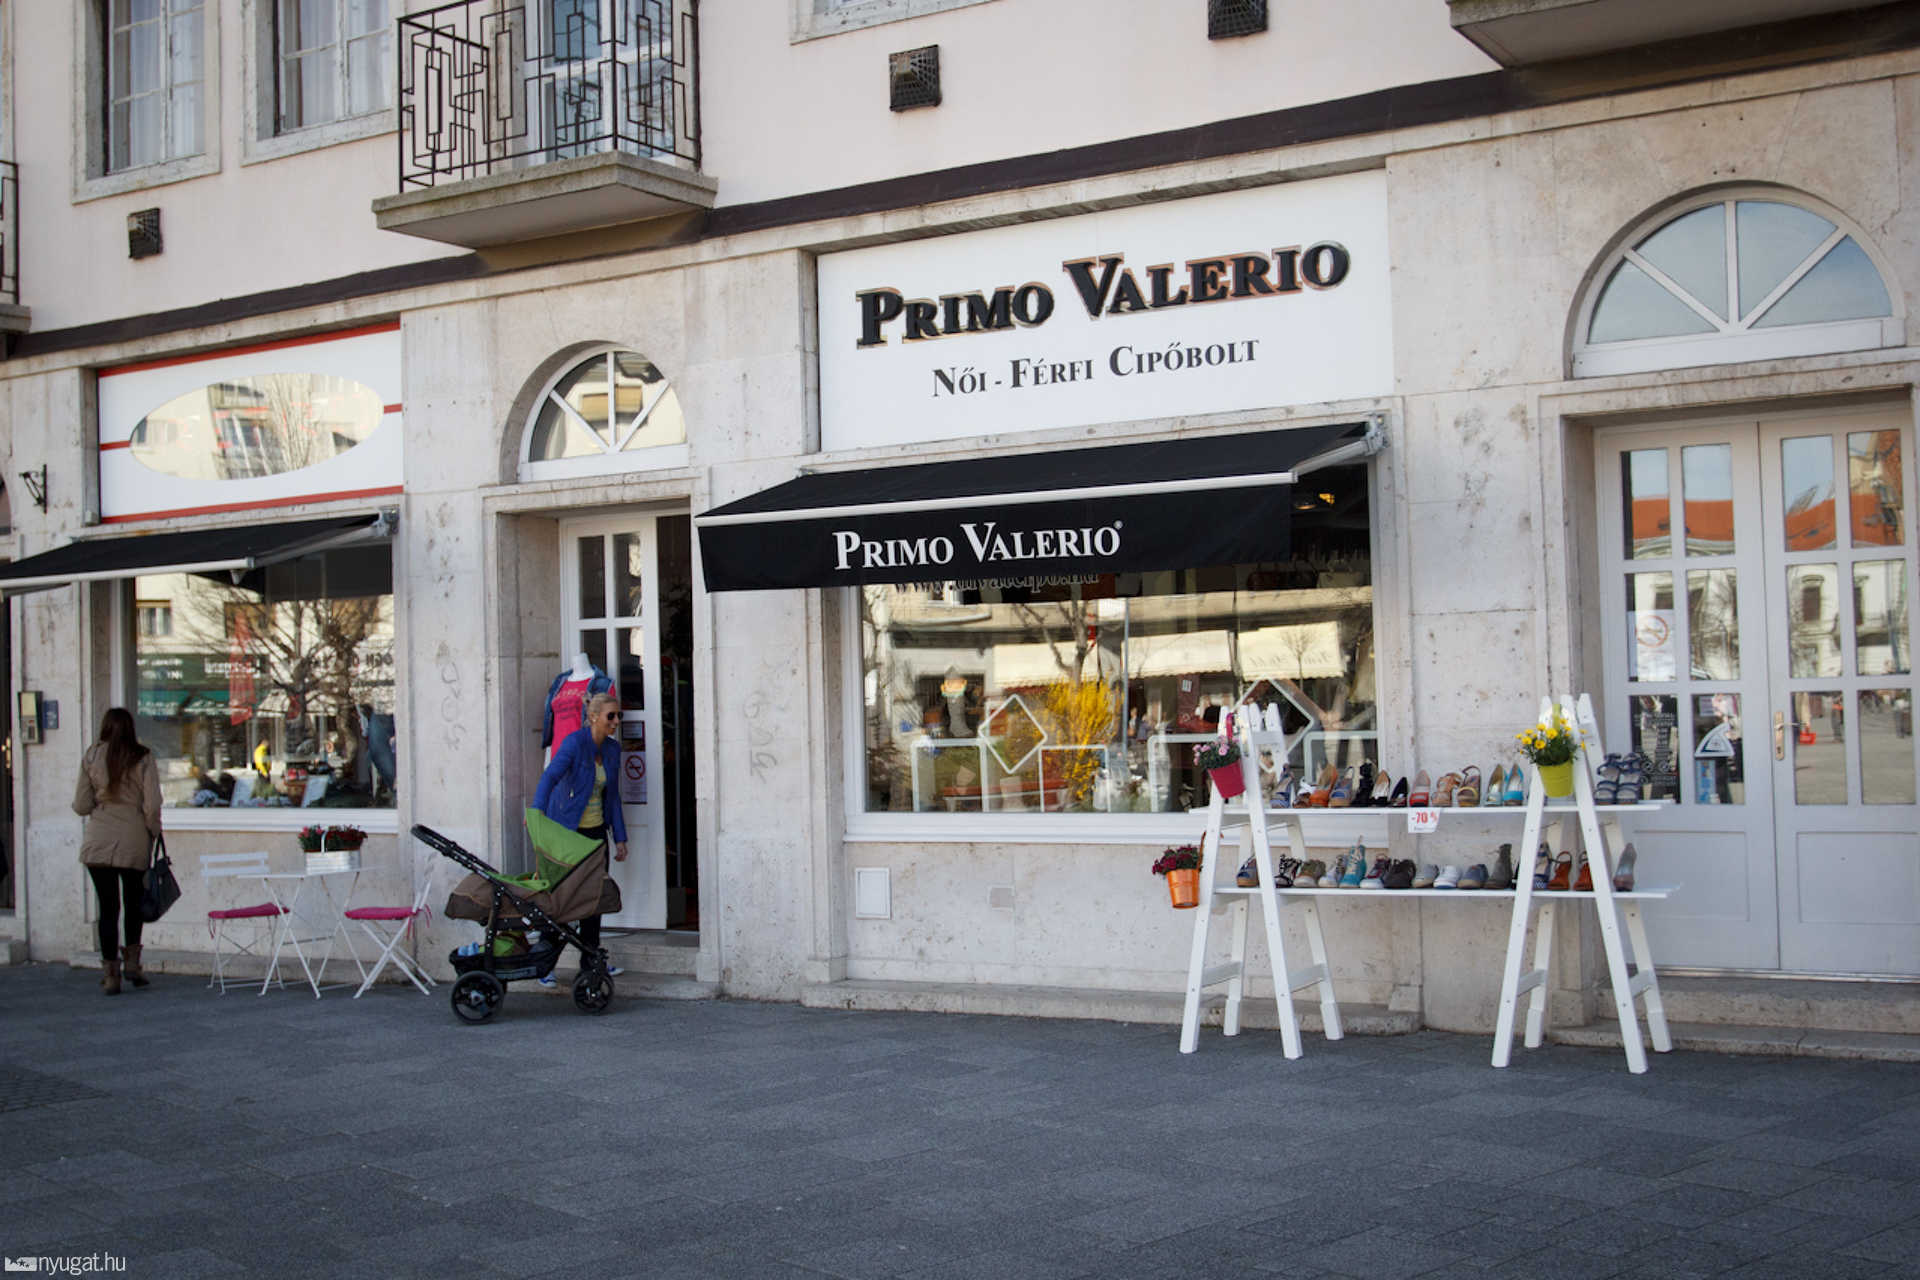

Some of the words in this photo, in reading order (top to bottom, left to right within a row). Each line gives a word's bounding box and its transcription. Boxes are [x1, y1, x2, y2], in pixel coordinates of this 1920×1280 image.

[855, 282, 1055, 350] PRIMO
[1062, 239, 1352, 322] VALERIO
[1010, 357, 1094, 389] FÉRFI
[1108, 339, 1260, 377] CIPŐBOLT
[832, 530, 954, 571] PRIMO
